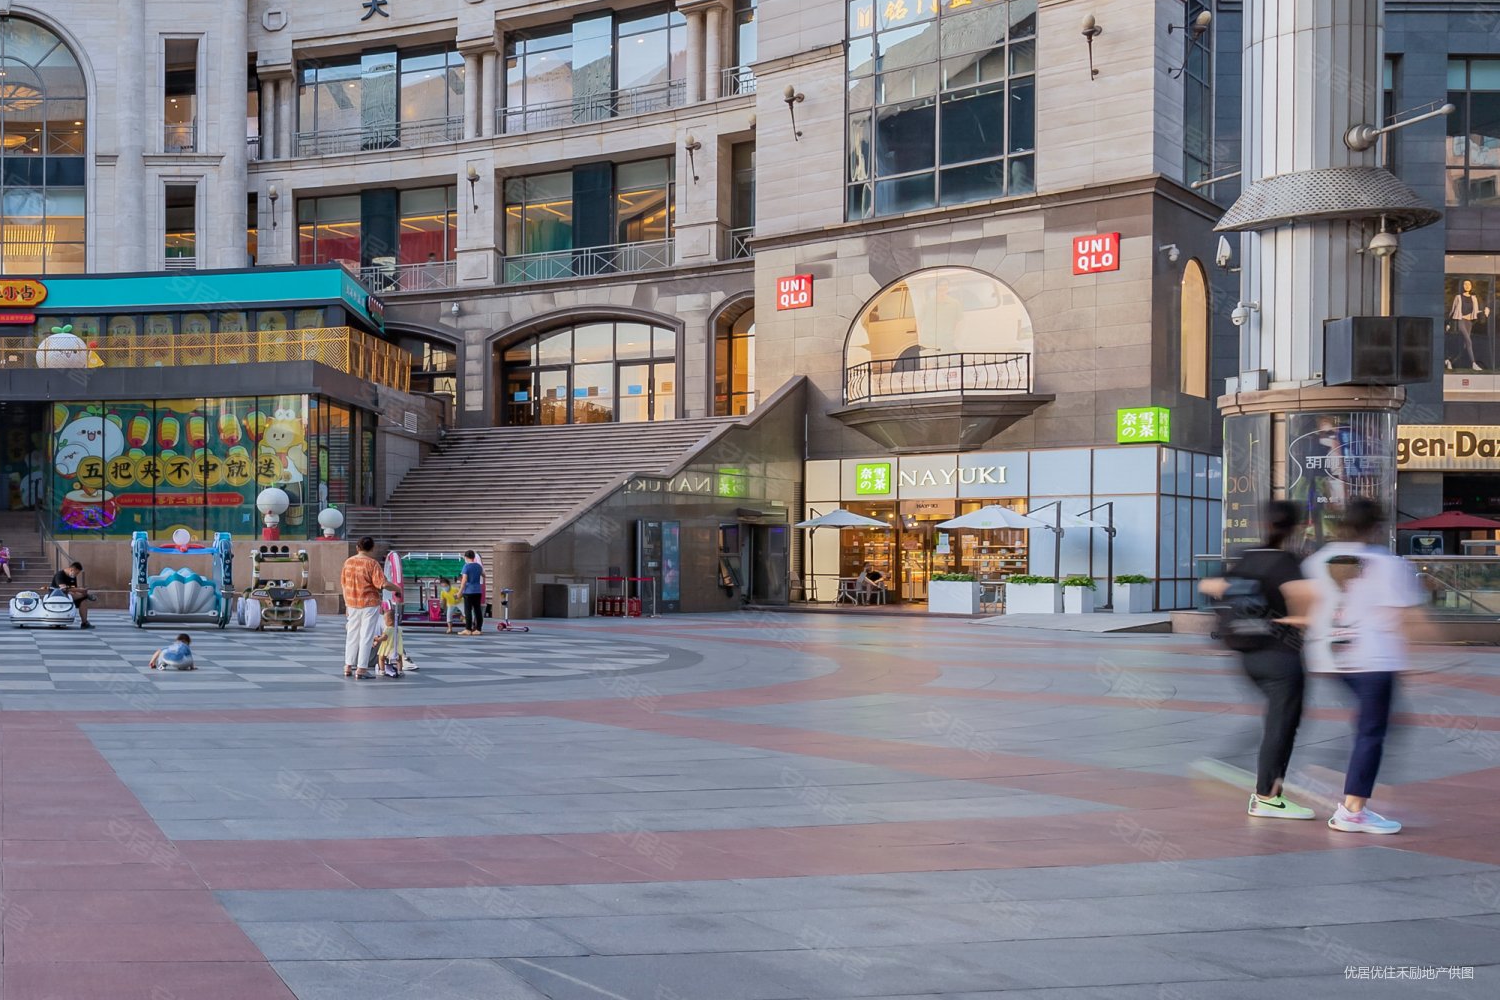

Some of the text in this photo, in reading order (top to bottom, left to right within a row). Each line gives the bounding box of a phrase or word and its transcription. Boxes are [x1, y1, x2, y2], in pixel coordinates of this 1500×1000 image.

[1077, 238, 1111, 255] UNI
[1077, 253, 1114, 270] QLO
[779, 278, 806, 293] UNI
[779, 291, 808, 307] QLO
[82, 459, 278, 480] 五把夹不中就送
[899, 466, 1007, 487] NAYUKI
